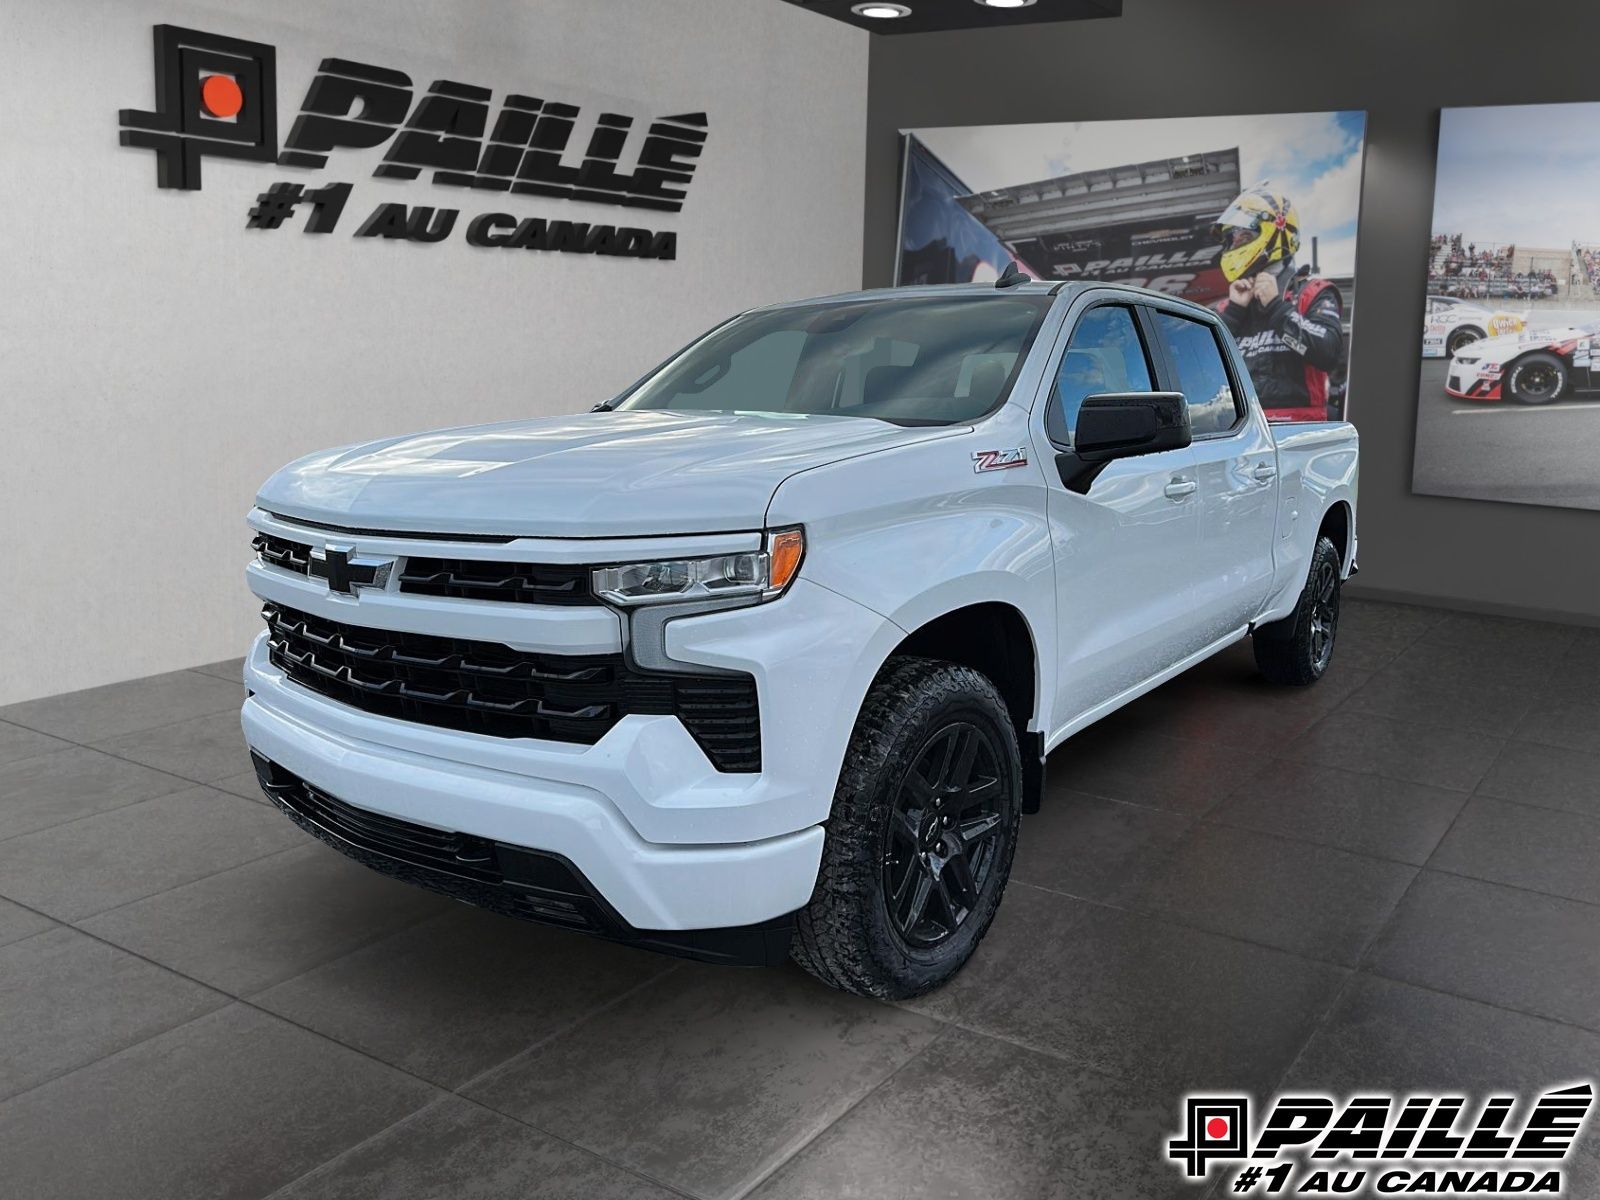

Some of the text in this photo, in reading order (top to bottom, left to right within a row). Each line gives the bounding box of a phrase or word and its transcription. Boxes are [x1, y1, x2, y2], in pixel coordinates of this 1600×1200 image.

[277, 57, 708, 212] PAILLÉ
[245, 182, 677, 260] #1 AU CANADA
[971, 447, 1028, 474] Z71
